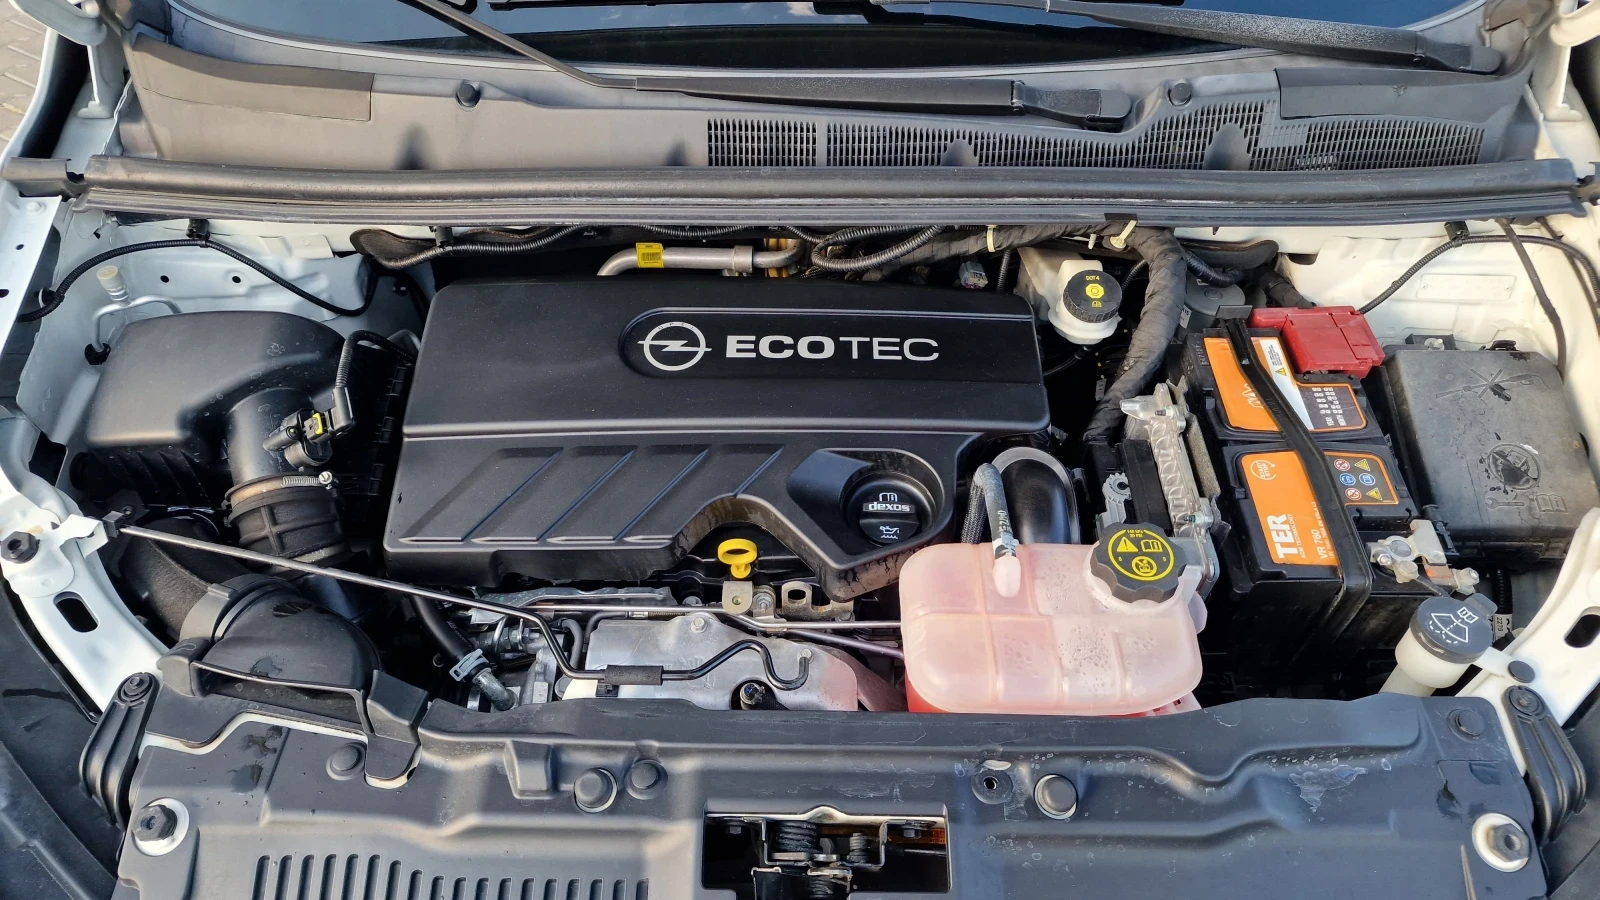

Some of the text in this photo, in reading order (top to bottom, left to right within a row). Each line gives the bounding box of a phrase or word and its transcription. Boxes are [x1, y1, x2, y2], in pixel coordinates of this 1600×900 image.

[725, 334, 939, 361] ECOTEC
[1325, 417, 1335, 426] YEAR
[1256, 462, 1265, 478] START
[1261, 463, 1270, 477] STOP
[868, 502, 910, 512] dexos
[1267, 513, 1299, 558] TER
[1287, 513, 1302, 546] TECHNOLOGY
[1311, 529, 1328, 559] VR 760
